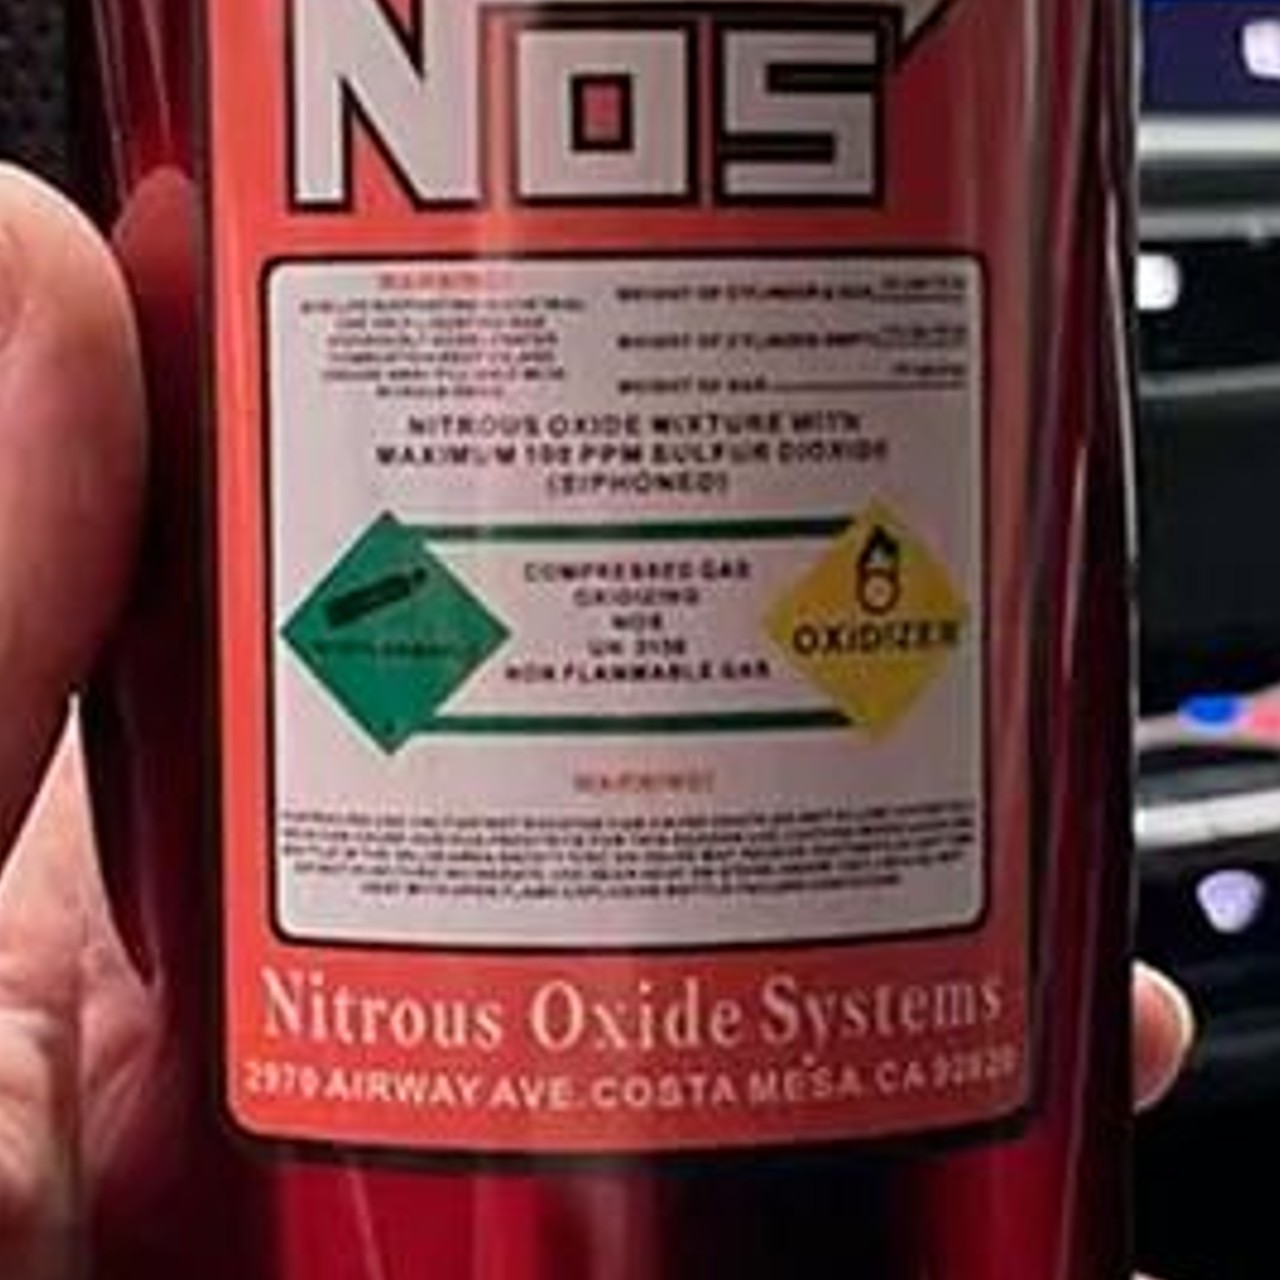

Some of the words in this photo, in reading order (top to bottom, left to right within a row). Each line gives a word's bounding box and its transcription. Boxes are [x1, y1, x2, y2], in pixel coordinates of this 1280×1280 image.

[408, 414, 540, 436] NITROUS
[547, 413, 640, 437] OXIDE
[652, 412, 780, 435] MIXTURE
[376, 444, 517, 466] MAXIMUM
[578, 442, 642, 465] PPM
[650, 440, 770, 465] SULFUR
[523, 562, 694, 583] COMPRESSED
[700, 557, 753, 581] GAS
[792, 620, 960, 656] OXIDIZER
[259, 967, 504, 1053] Nitrous
[531, 976, 744, 1051] Oxide
[760, 972, 1004, 1052] Systems
[323, 1065, 483, 1106] AIRWAY
[590, 1073, 738, 1112] COSTA
